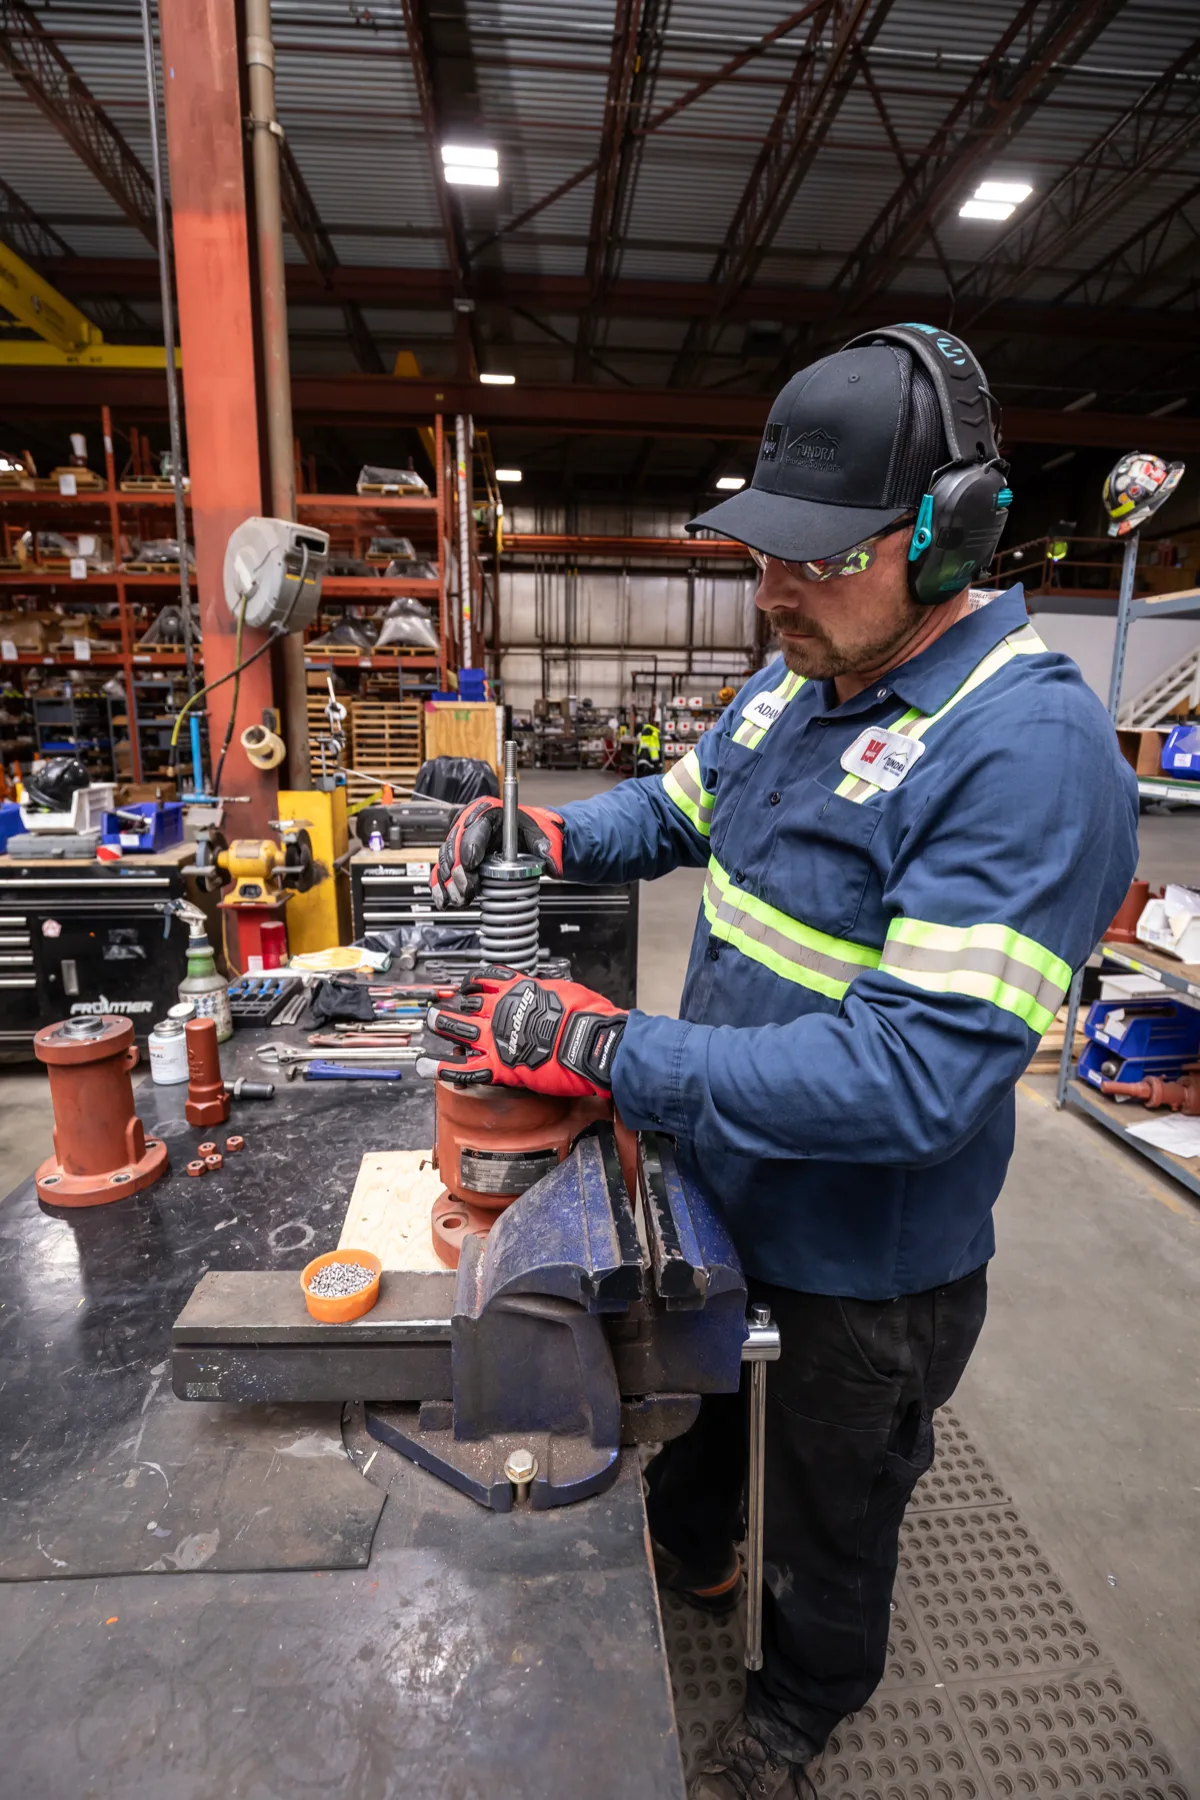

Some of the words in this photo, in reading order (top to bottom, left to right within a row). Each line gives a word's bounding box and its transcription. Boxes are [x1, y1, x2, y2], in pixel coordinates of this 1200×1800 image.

[796, 444, 834, 460] TUNDRA
[70, 995, 153, 1015] FRONTIER
[509, 987, 535, 1055] Snap-on
